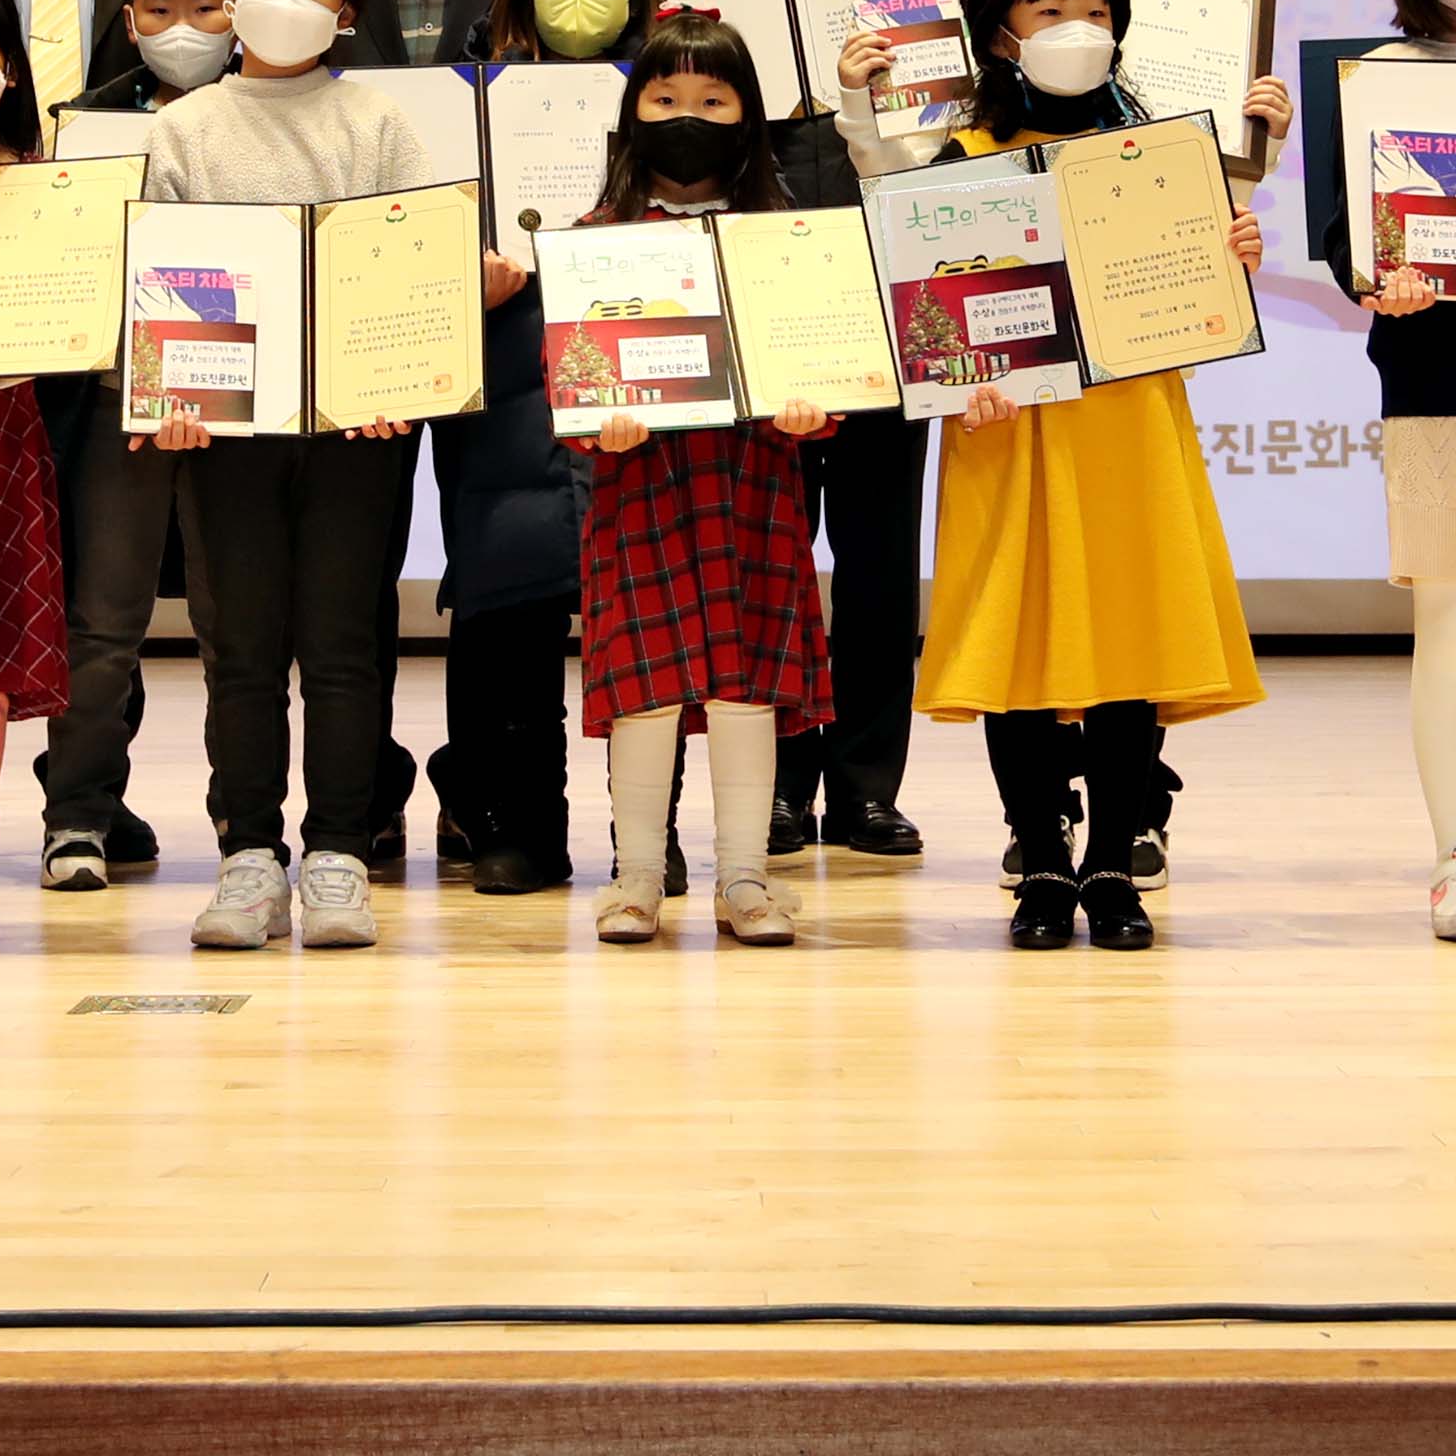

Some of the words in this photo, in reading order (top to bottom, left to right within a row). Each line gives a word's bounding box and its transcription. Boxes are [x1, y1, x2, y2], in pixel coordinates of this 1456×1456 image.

[905, 199, 978, 242] 친구의
[980, 196, 1040, 225] 전설
[199, 271, 254, 290] 차일드
[994, 319, 1051, 337] 화도진문화원
[189, 372, 248, 386] 화도진문화원
